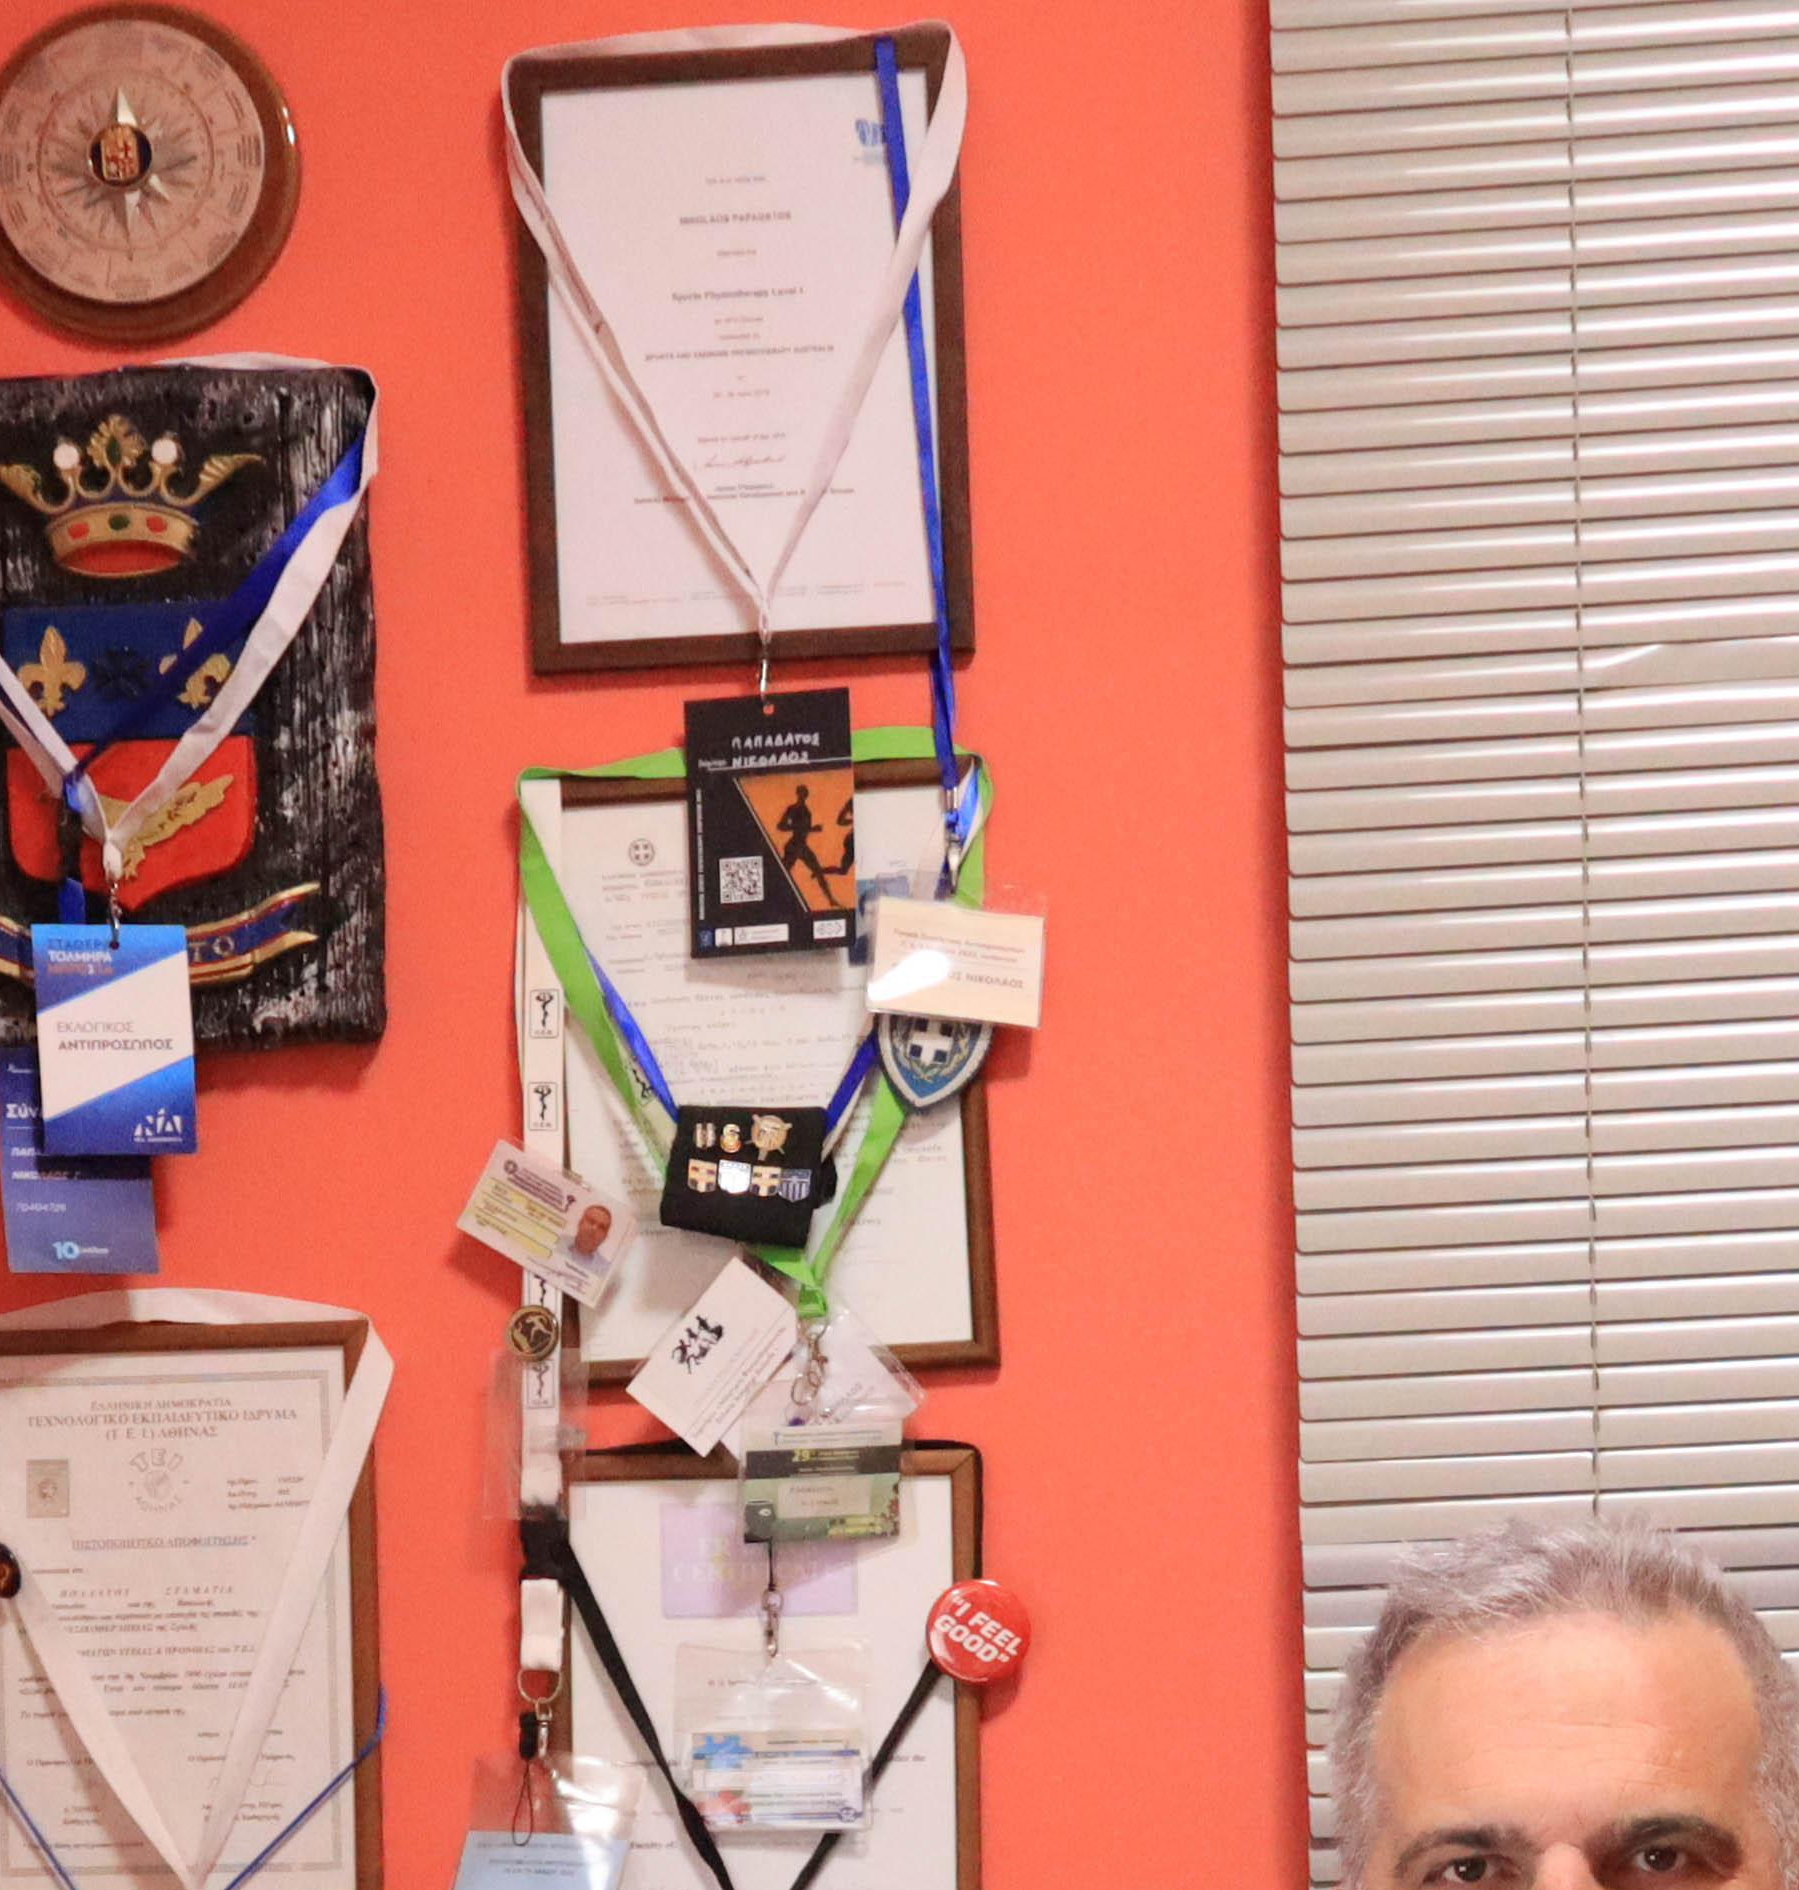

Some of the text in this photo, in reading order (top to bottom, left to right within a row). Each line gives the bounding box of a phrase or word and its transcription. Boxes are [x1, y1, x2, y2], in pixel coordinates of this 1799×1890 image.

[56, 1021, 134, 1033] ΕΚΛΟΓΙΚΟΣ
[58, 1038, 174, 1051] ΑΝΤΙΠΡΟΣΩΠΟΣ
[26, 1408, 297, 1428] ΤΕΧΝΟΛΟΓΙΚΟ ΕΚΠΑΙΔΕΥΤΙΚΟ ΙΔΡΥΜΑ
[158, 1425, 219, 1439] ΑΘΗΝΑΣ
[968, 1611, 1023, 1656] FEEL
